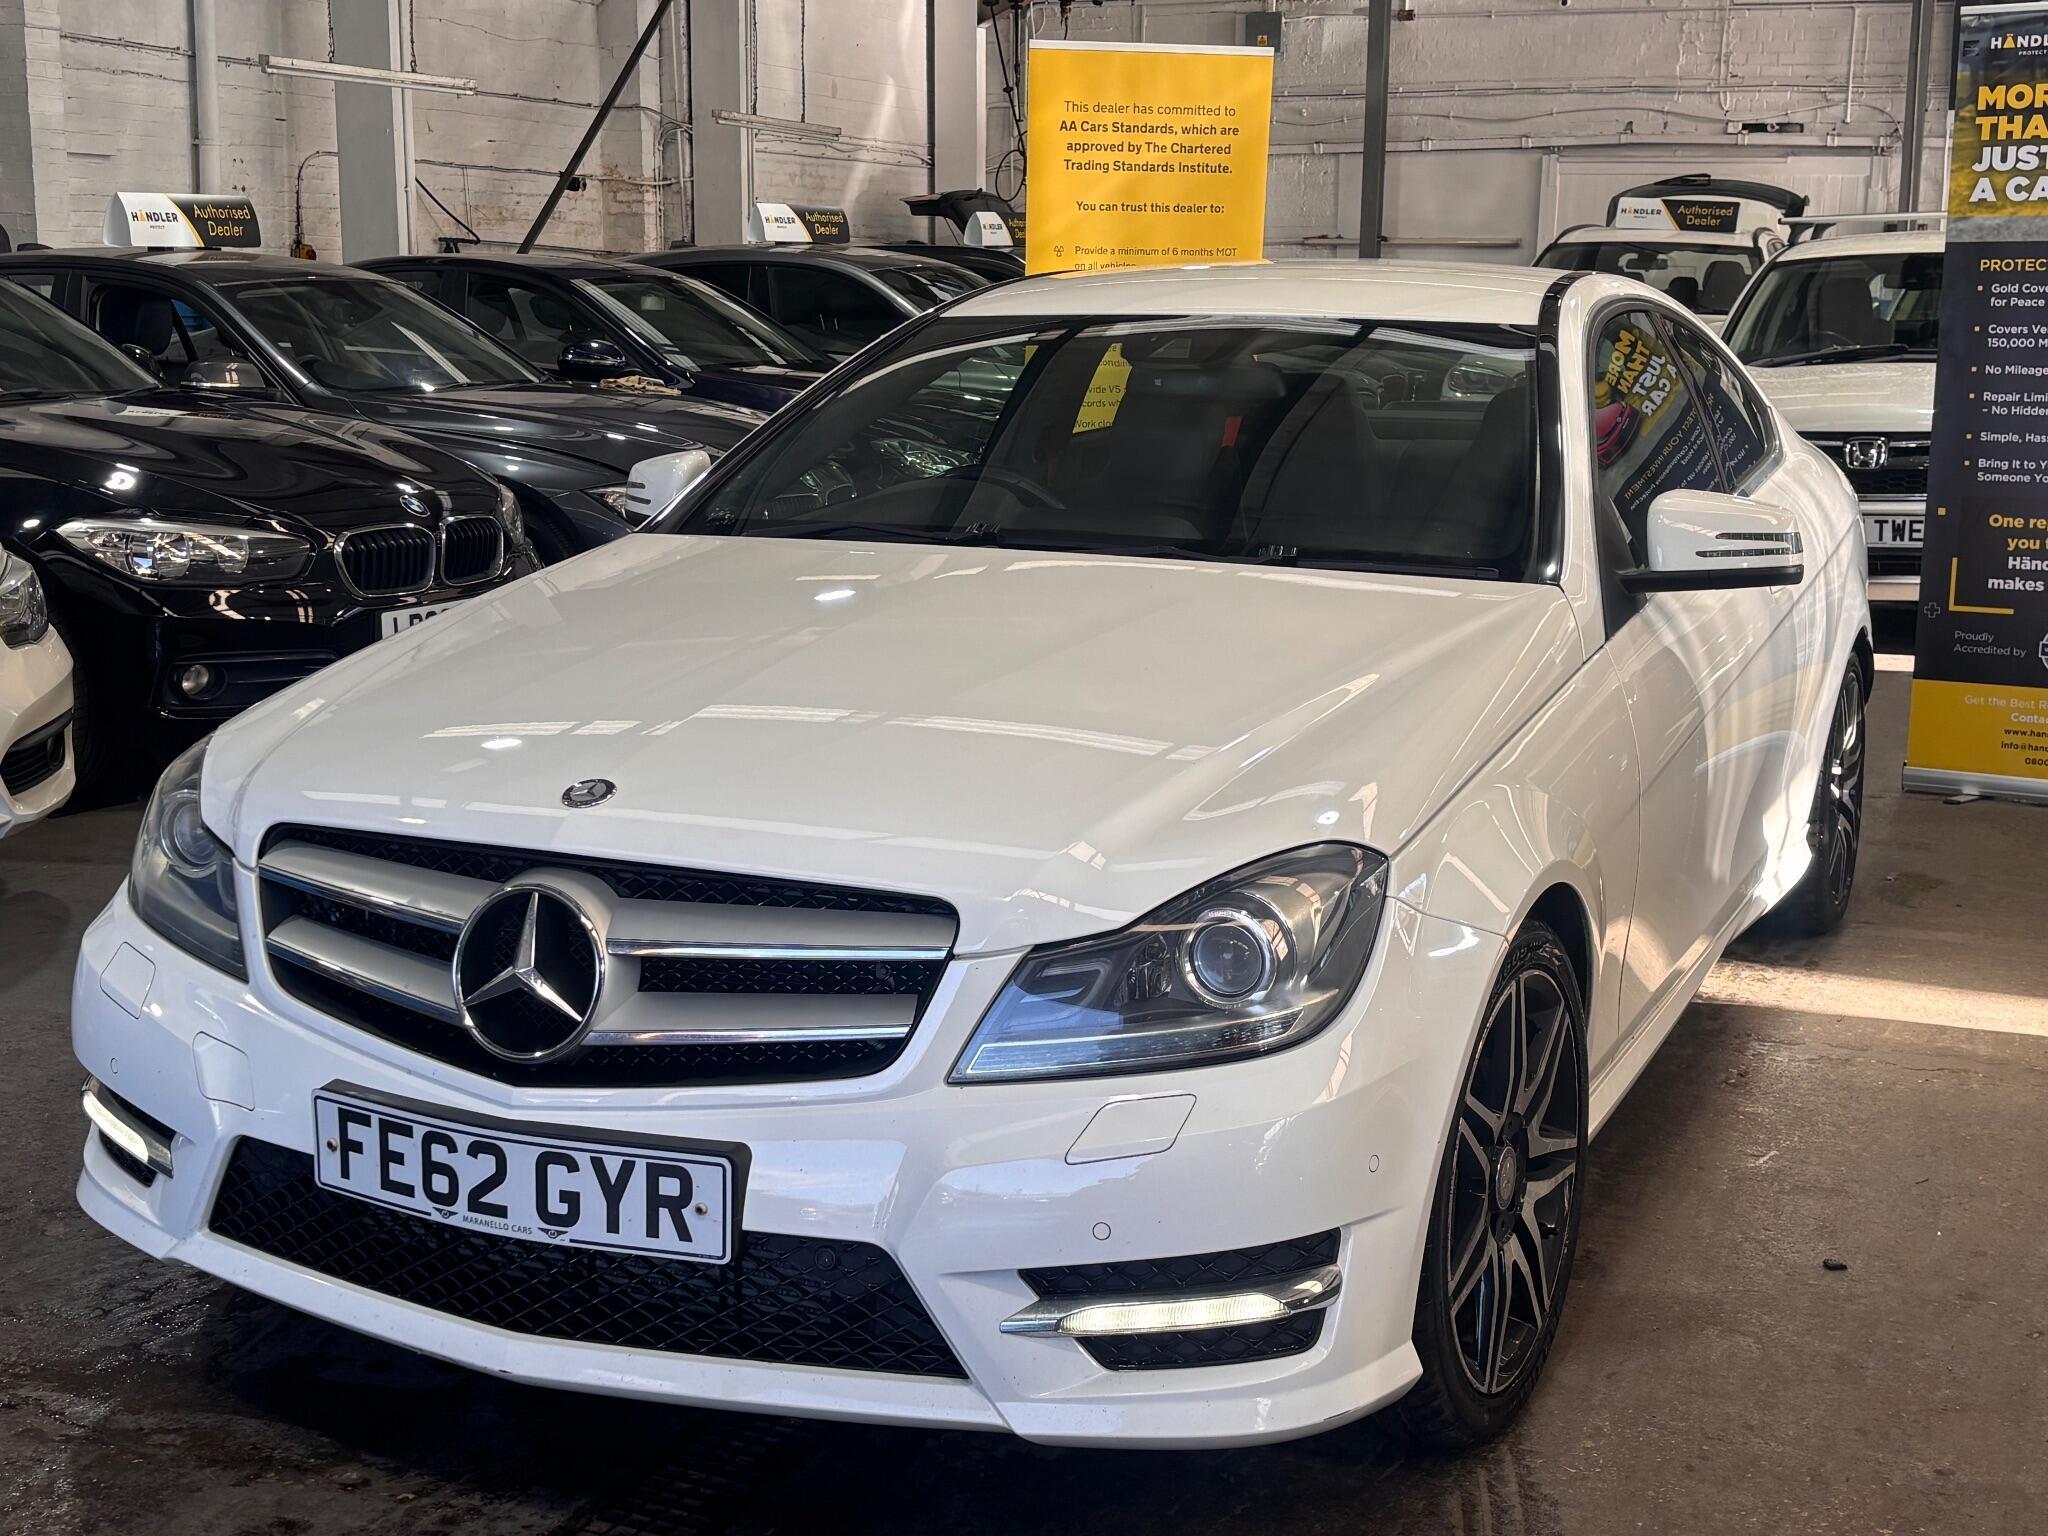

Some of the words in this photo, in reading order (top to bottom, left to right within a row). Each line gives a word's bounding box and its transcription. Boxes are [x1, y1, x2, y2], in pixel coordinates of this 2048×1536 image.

[1064, 100, 1089, 113] This
[1093, 102, 1129, 114] dealer
[1133, 104, 1153, 115] has
[1157, 105, 1221, 117] committed
[1224, 106, 1236, 117] to
[1059, 120, 1078, 132] AA
[1080, 120, 1109, 133] Cars
[1111, 122, 1178, 136] Standards,
[1181, 124, 1217, 136] which
[1220, 126, 1240, 136] are
[1066, 142, 1124, 153] approved
[1128, 142, 1142, 155] by
[1145, 142, 1167, 153] The
[1171, 142, 1232, 155] Chartered
[1064, 159, 1109, 173] Trading
[1112, 160, 1175, 173] Standards
[1178, 162, 1233, 174] Institute.
[1968, 177, 1997, 203] A
[193, 204, 251, 220] Authorised
[1076, 200, 1096, 212] You
[1099, 203, 1118, 212] can
[1121, 202, 1148, 213] trust
[1150, 202, 1170, 213] this
[1173, 203, 1208, 214] dealer
[1209, 204, 1225, 214] to:
[1678, 205, 1734, 216] Authorised
[805, 212, 844, 223] Authorised
[1686, 216, 1721, 226] Dealer
[207, 221, 244, 237] Dealer
[814, 224, 839, 235] Dealer
[1075, 246, 1108, 255] Provide
[1118, 246, 1159, 256] minimum
[1161, 247, 1170, 256] of
[1172, 248, 1179, 256] 6
[1180, 248, 1214, 257] months
[1216, 248, 1238, 257] MOT
[1088, 262, 1098, 270] all
[1991, 283, 2019, 293] Gold
[1990, 297, 2007, 306] for
[2010, 298, 2045, 306] Peace
[1988, 324, 2028, 334] Covers
[1988, 338, 2035, 349] 150,000
[1985, 366, 2002, 374] No
[1109, 386, 1121, 394] V5
[1983, 392, 2021, 402] Repair
[1991, 406, 2008, 415] No
[1980, 432, 2022, 443] Simple,
[2025, 433, 2048, 443] Has
[1978, 459, 2008, 470] Bring
[2012, 459, 2021, 469] It
[2024, 460, 2036, 469] to
[1977, 472, 2031, 482] Someone
[1989, 514, 2024, 528] One
[2029, 518, 2048, 532] re
[1874, 520, 1924, 542] TWE
[2007, 538, 2040, 551] you
[1987, 577, 2045, 591] makes
[1955, 631, 1994, 643] Proudly
[1954, 644, 2010, 655] Accredited
[2013, 648, 2026, 658] by
[1965, 695, 1984, 704] Get
[1988, 696, 2006, 706] the
[2010, 698, 2035, 709] Best
[2004, 729, 2048, 738] www.han
[337, 1107, 508, 1219] FE62
[535, 1151, 693, 1243] GYR
[463, 1215, 509, 1231] MARANELLO
[511, 1224, 533, 1236] CARS
